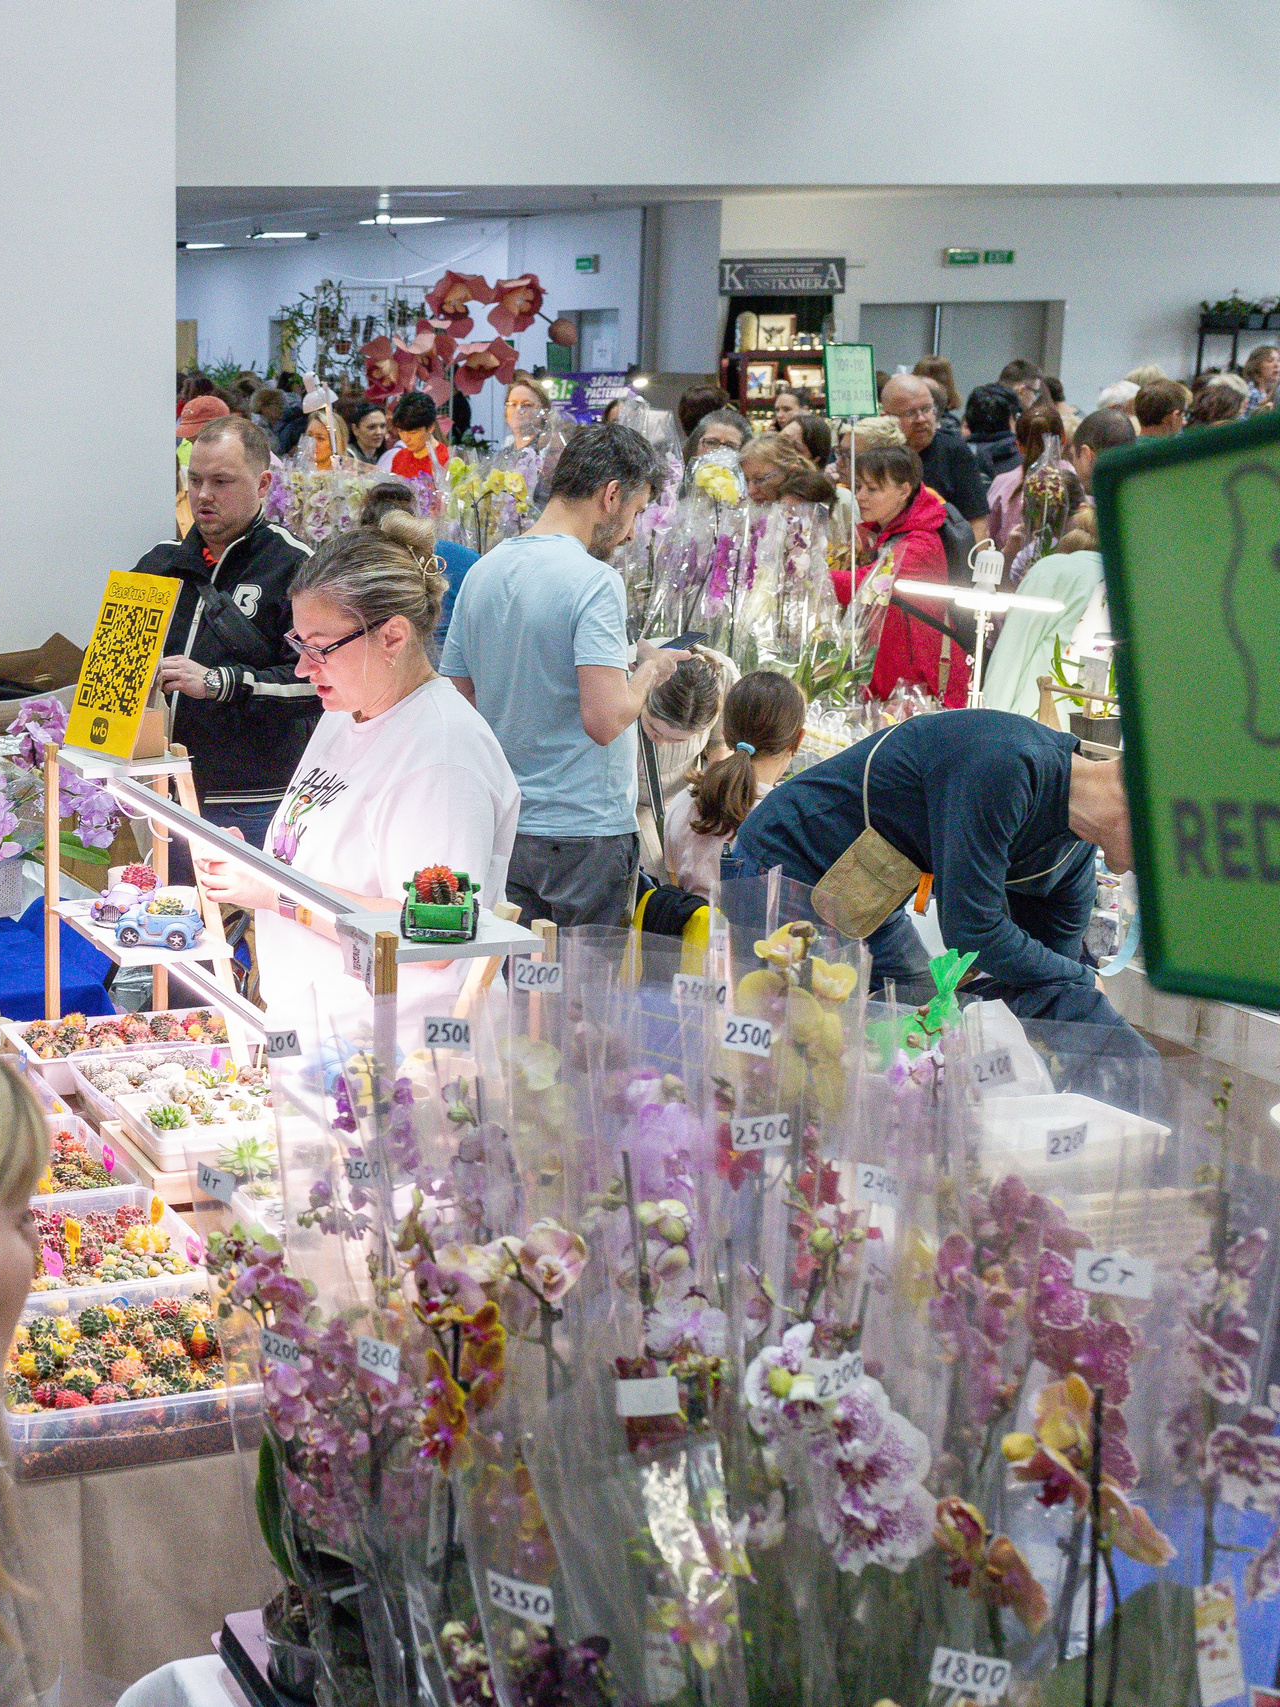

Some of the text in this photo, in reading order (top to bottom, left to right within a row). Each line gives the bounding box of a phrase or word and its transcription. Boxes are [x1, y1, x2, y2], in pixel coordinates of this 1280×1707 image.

[108, 582, 170, 605] Cactus Pet
[92, 723, 107, 738] wb
[517, 963, 559, 986] 2200
[725, 1021, 770, 1050] 2500
[735, 1118, 791, 1146] 2500
[263, 1333, 301, 1363] 2200
[491, 1579, 550, 1616] 2350
[936, 1655, 1007, 1688] 1800
